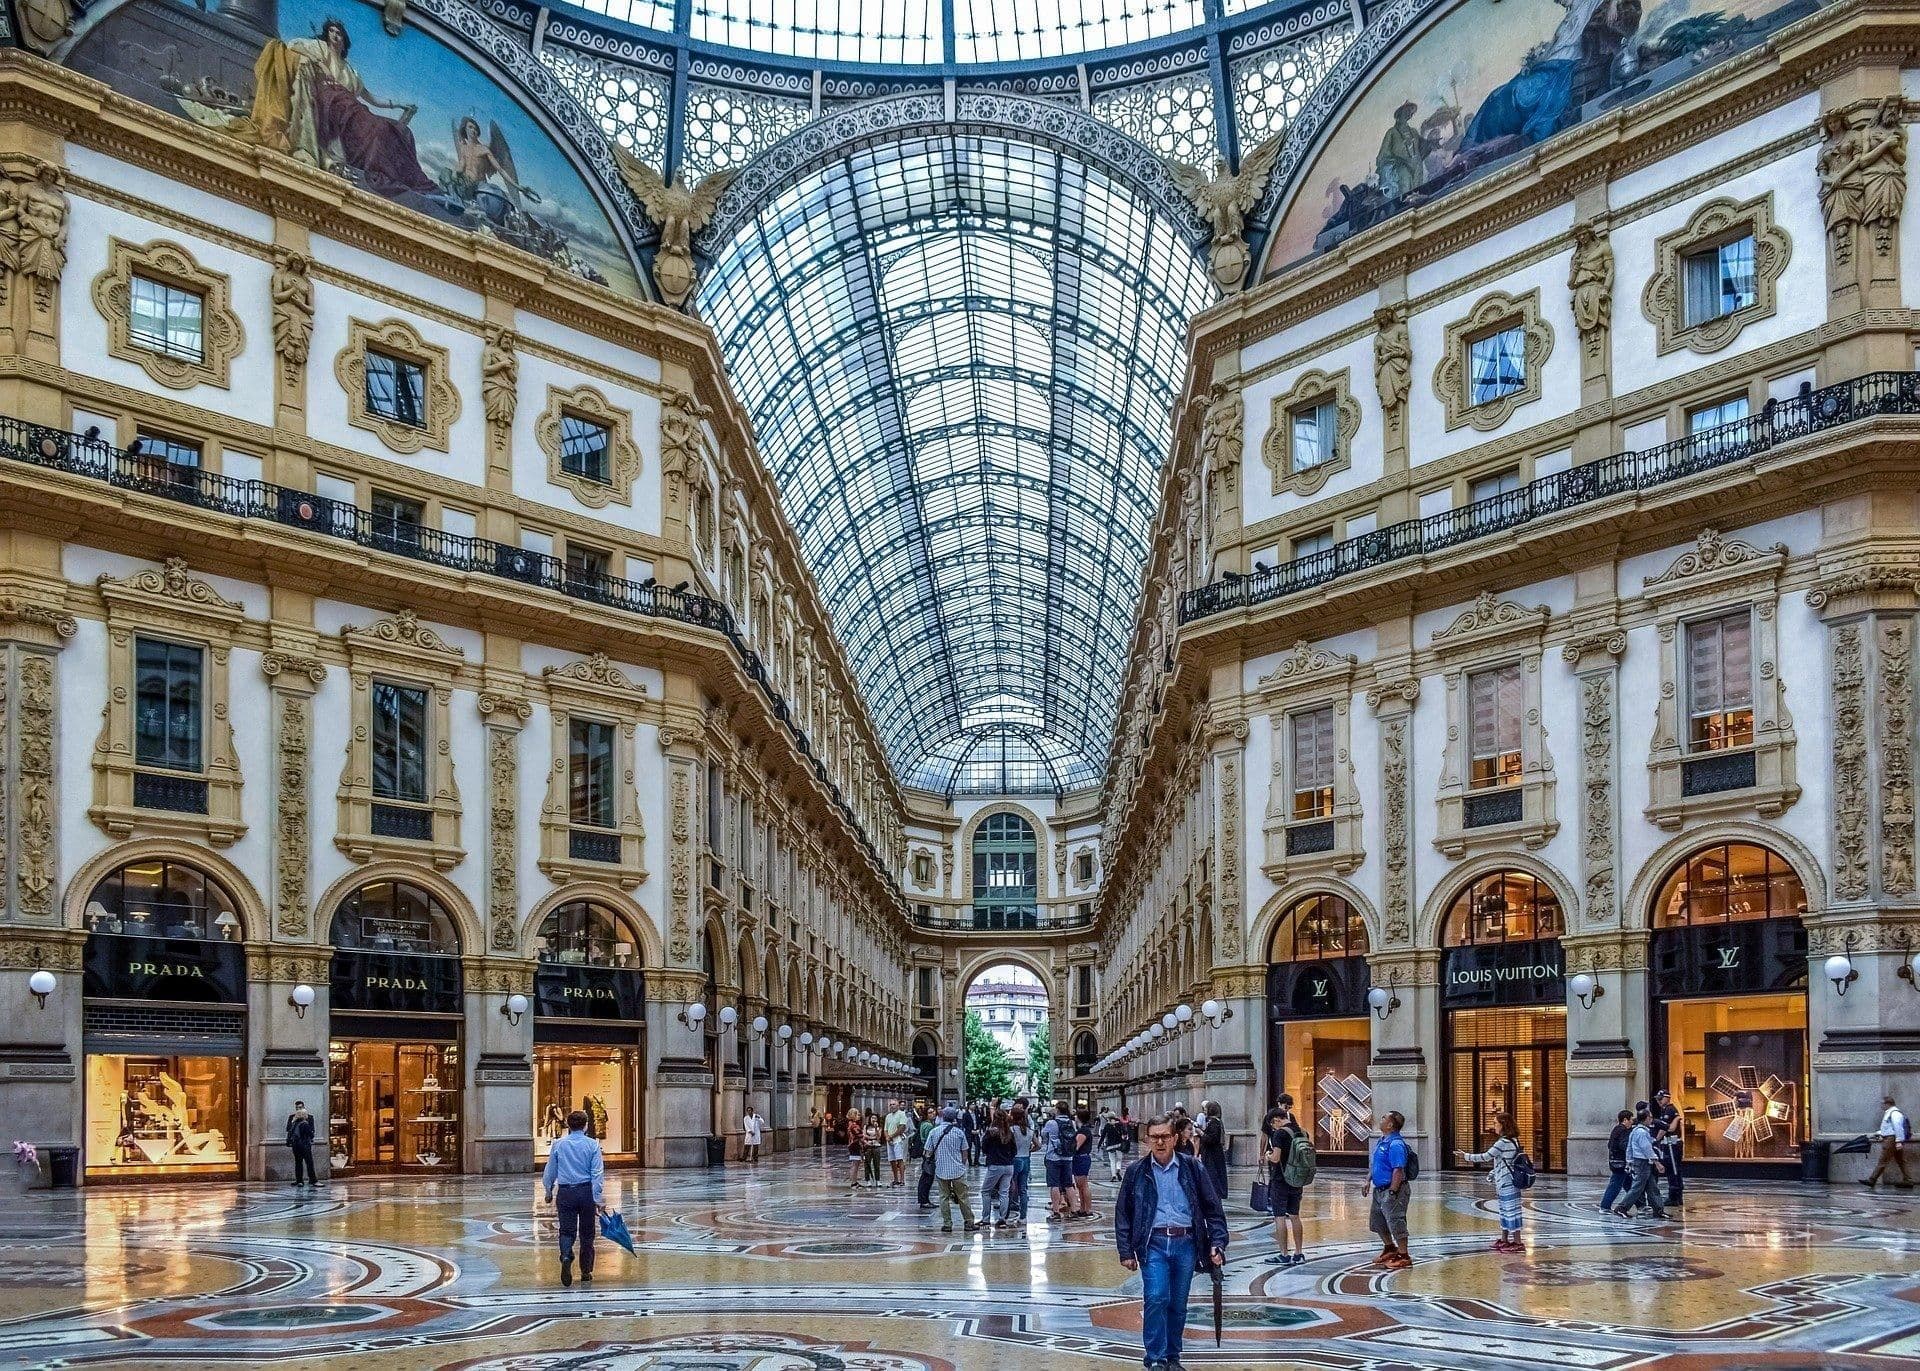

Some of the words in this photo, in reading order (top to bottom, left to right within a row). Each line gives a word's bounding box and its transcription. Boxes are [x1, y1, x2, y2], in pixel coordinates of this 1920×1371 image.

[129, 962, 204, 978] PRADA
[1452, 969, 1493, 984] LOUIS
[1495, 964, 1559, 981] VUITTON
[366, 976, 428, 990] PRADA
[563, 987, 615, 999] PRADA
